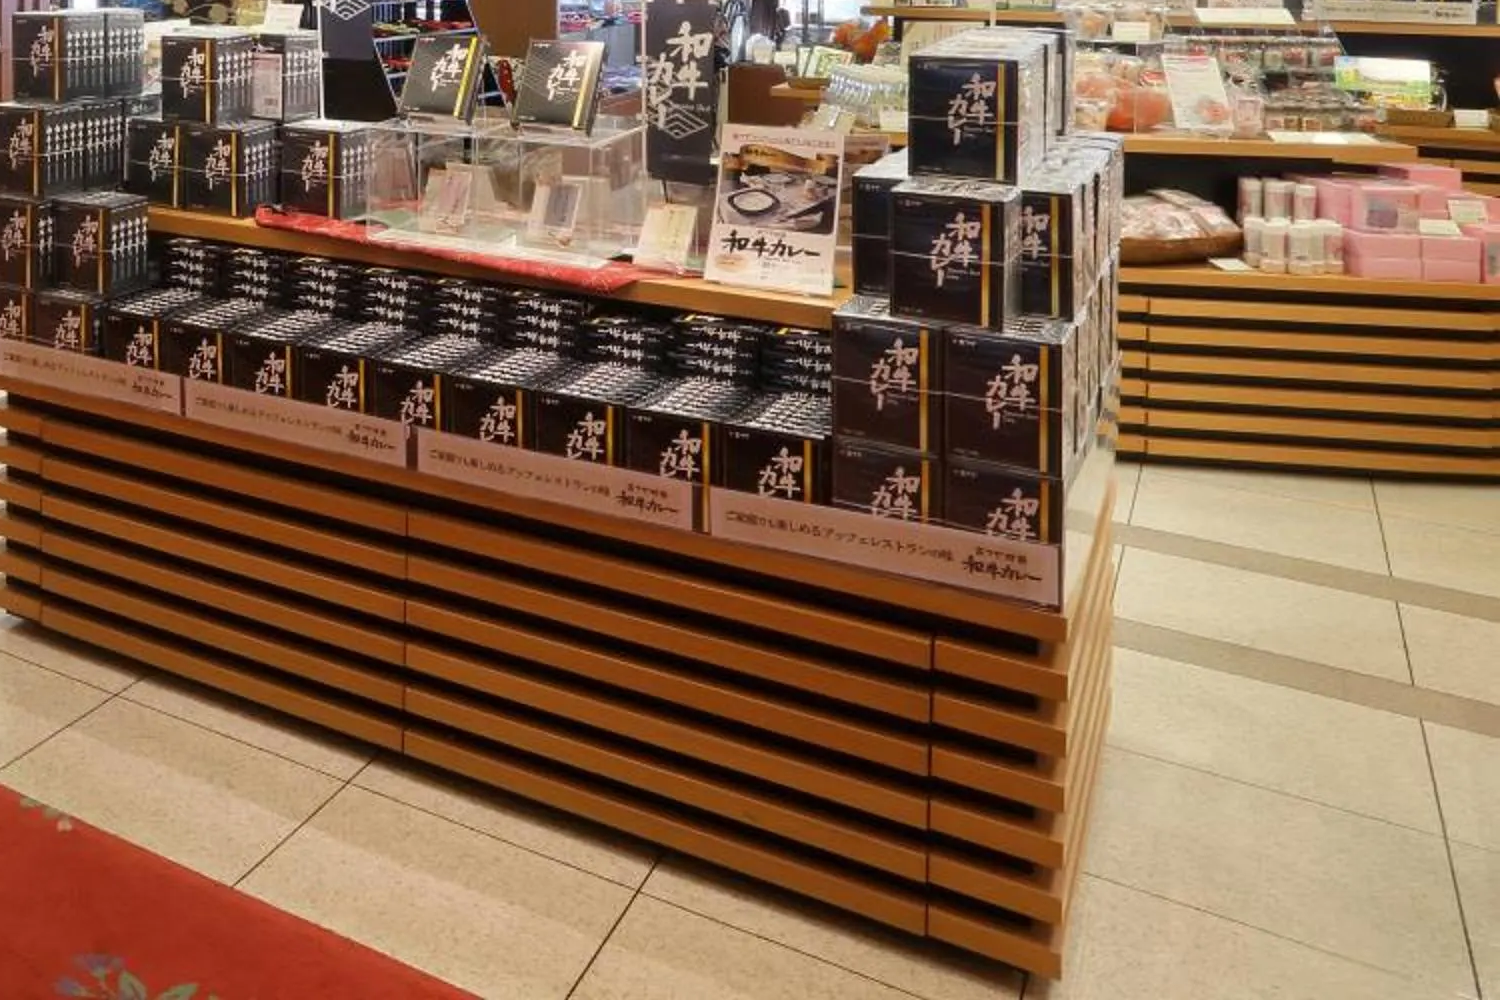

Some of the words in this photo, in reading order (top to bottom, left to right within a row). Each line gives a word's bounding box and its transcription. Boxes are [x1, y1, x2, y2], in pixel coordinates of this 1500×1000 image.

[187, 48, 205, 87] 和牛
[563, 50, 587, 86] 和牛
[666, 21, 713, 100] 和牛
[961, 72, 997, 126] 和牛
[721, 230, 820, 258] 和牛カレー
[945, 211, 981, 267] 和牛
[1021, 206, 1050, 259] 和牛
[126, 341, 139, 365] カレ
[189, 353, 201, 379] カレ
[198, 338, 217, 380] 和牛
[264, 351, 285, 395] 和牛
[885, 338, 919, 392] 和牛
[255, 366, 268, 393] カレ
[326, 382, 340, 407] カレ
[335, 365, 359, 408] 和牛
[1001, 353, 1039, 411] 和牛
[410, 379, 434, 425] 和牛
[489, 396, 517, 443] 和牛
[479, 413, 495, 441] カレ
[567, 429, 582, 459] カレ
[578, 412, 606, 460] 和牛
[660, 447, 677, 478] カレ
[672, 429, 702, 480] 和牛
[771, 447, 803, 498] 和牛
[759, 465, 777, 496] カレ
[886, 466, 920, 520] 和牛
[1001, 487, 1040, 541] 和牛
[961, 554, 1043, 581] 和牛カレー
